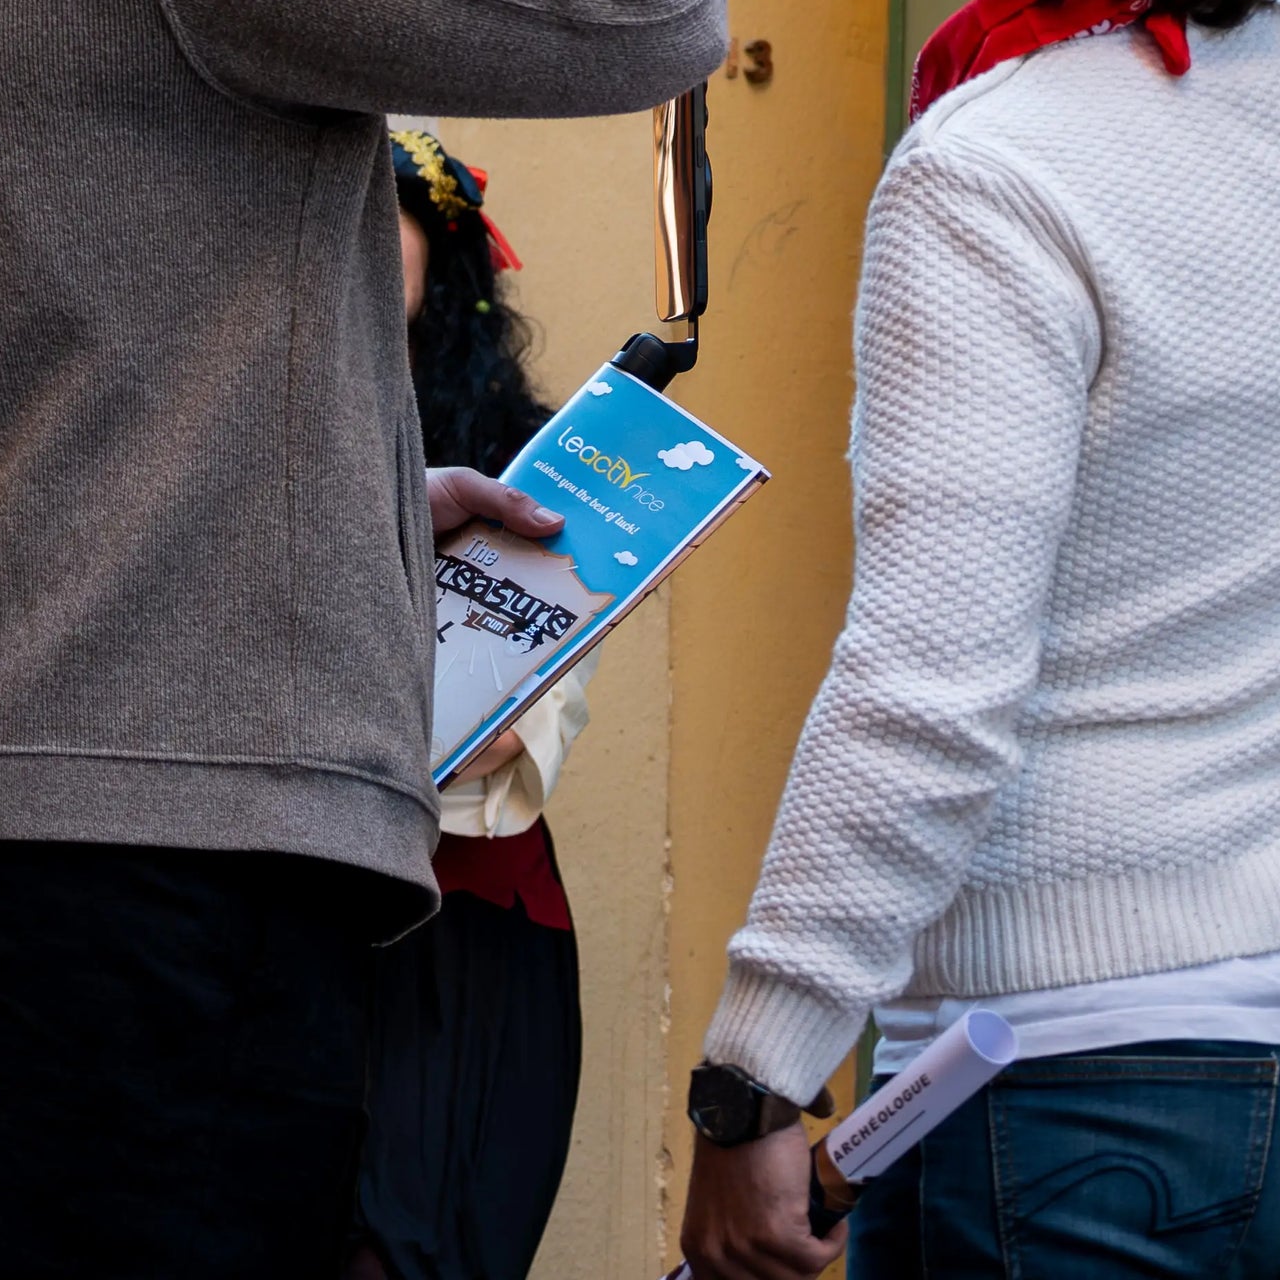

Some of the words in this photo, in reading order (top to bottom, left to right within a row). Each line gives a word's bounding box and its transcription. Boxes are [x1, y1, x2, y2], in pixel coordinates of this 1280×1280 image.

[533, 459, 562, 482] wishes
[557, 478, 579, 494] you
[575, 487, 592, 503] the
[589, 497, 610, 515] best
[604, 509, 621, 522] of
[614, 515, 641, 535] luck!
[464, 535, 500, 567] The
[435, 556, 577, 640] reasure
[481, 615, 510, 634] run!
